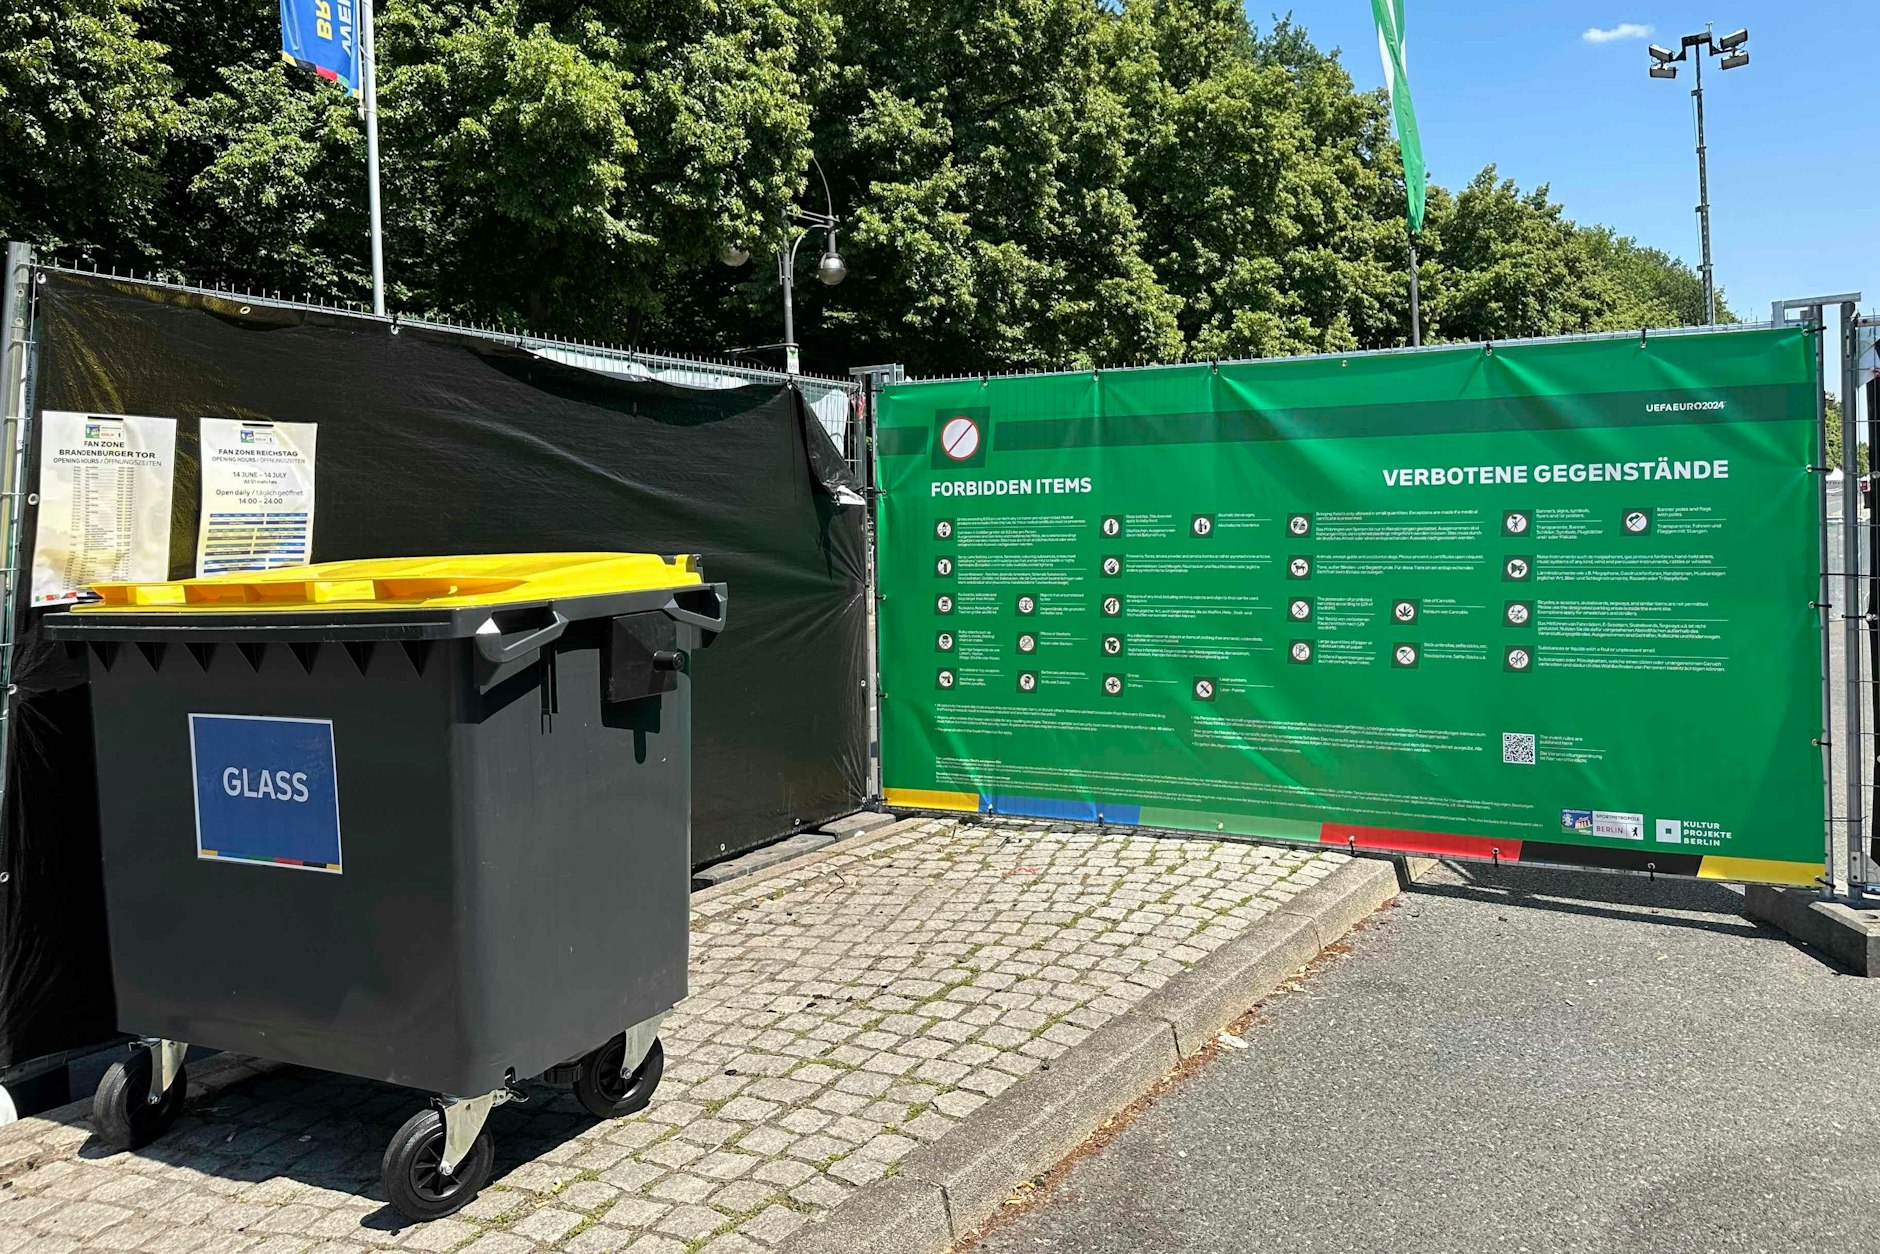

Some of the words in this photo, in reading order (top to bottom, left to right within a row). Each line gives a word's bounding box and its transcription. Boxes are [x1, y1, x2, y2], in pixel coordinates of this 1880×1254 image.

[59, 449, 133, 458] BRANDENBURGER
[104, 458, 161, 466] ÖFFNUNGSZEITEN
[1383, 465, 1528, 487] VERBOTENE
[1533, 456, 1729, 483] GEGENSTÄNDE
[931, 479, 1032, 497] FORBIDDEN
[1036, 477, 1092, 494] ITEMS
[223, 767, 309, 803] GLASS
[1684, 821, 1720, 829] KULTUR
[1684, 829, 1732, 838] PROJEKTE
[1684, 838, 1720, 846] BERLIN
